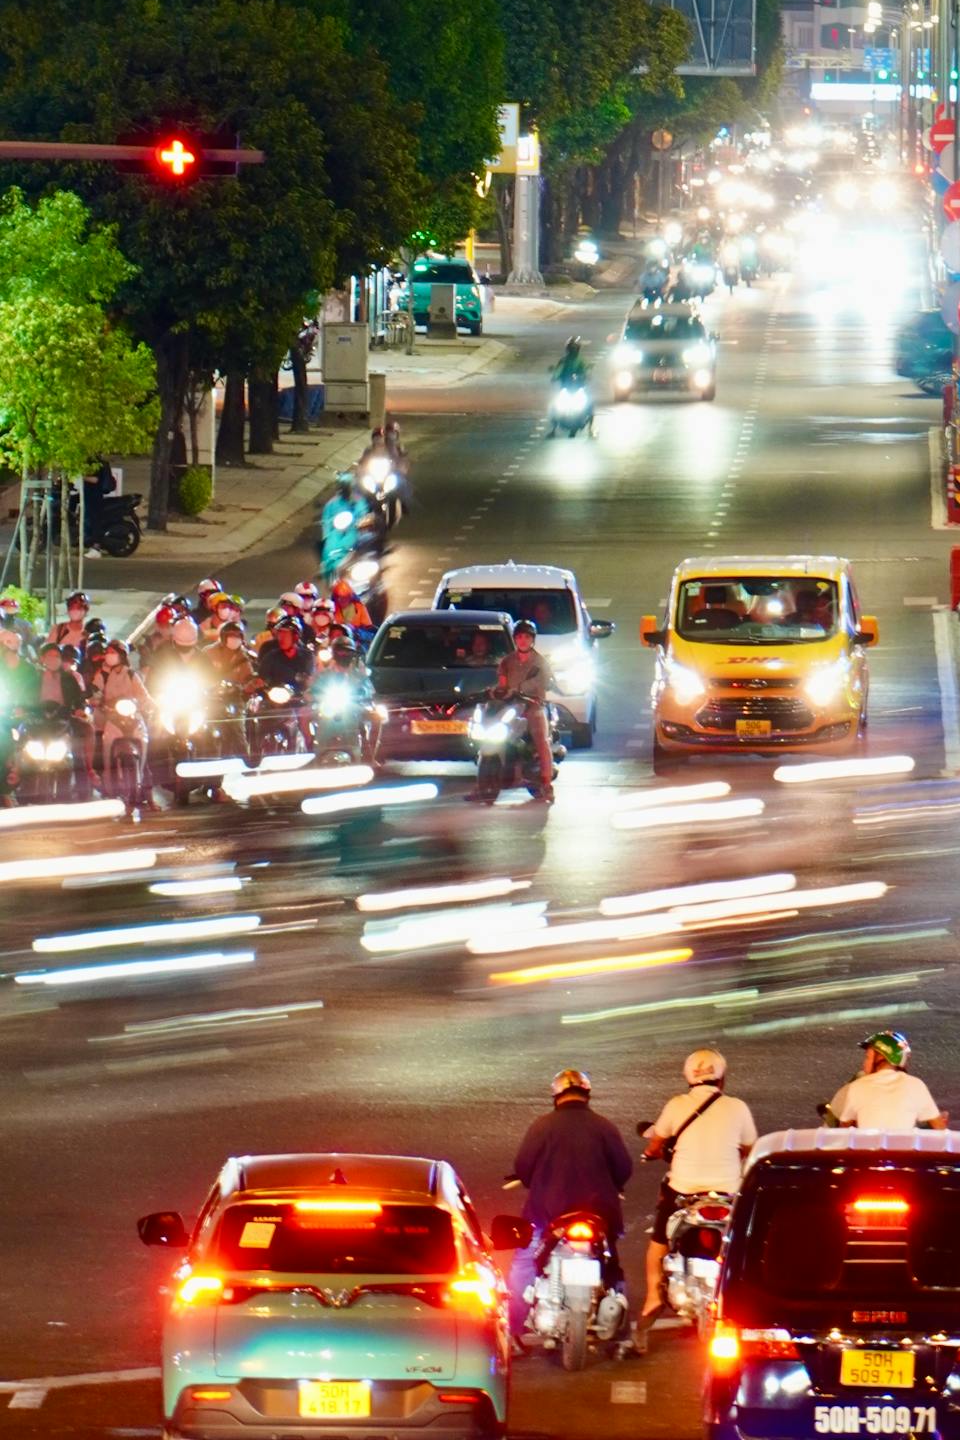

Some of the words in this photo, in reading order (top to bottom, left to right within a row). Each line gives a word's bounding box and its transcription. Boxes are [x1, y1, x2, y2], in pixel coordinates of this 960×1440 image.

[863, 1352, 893, 1367] 50H
[850, 1368, 903, 1383] 509.71
[814, 1406, 937, 1434] 50H-509.71
